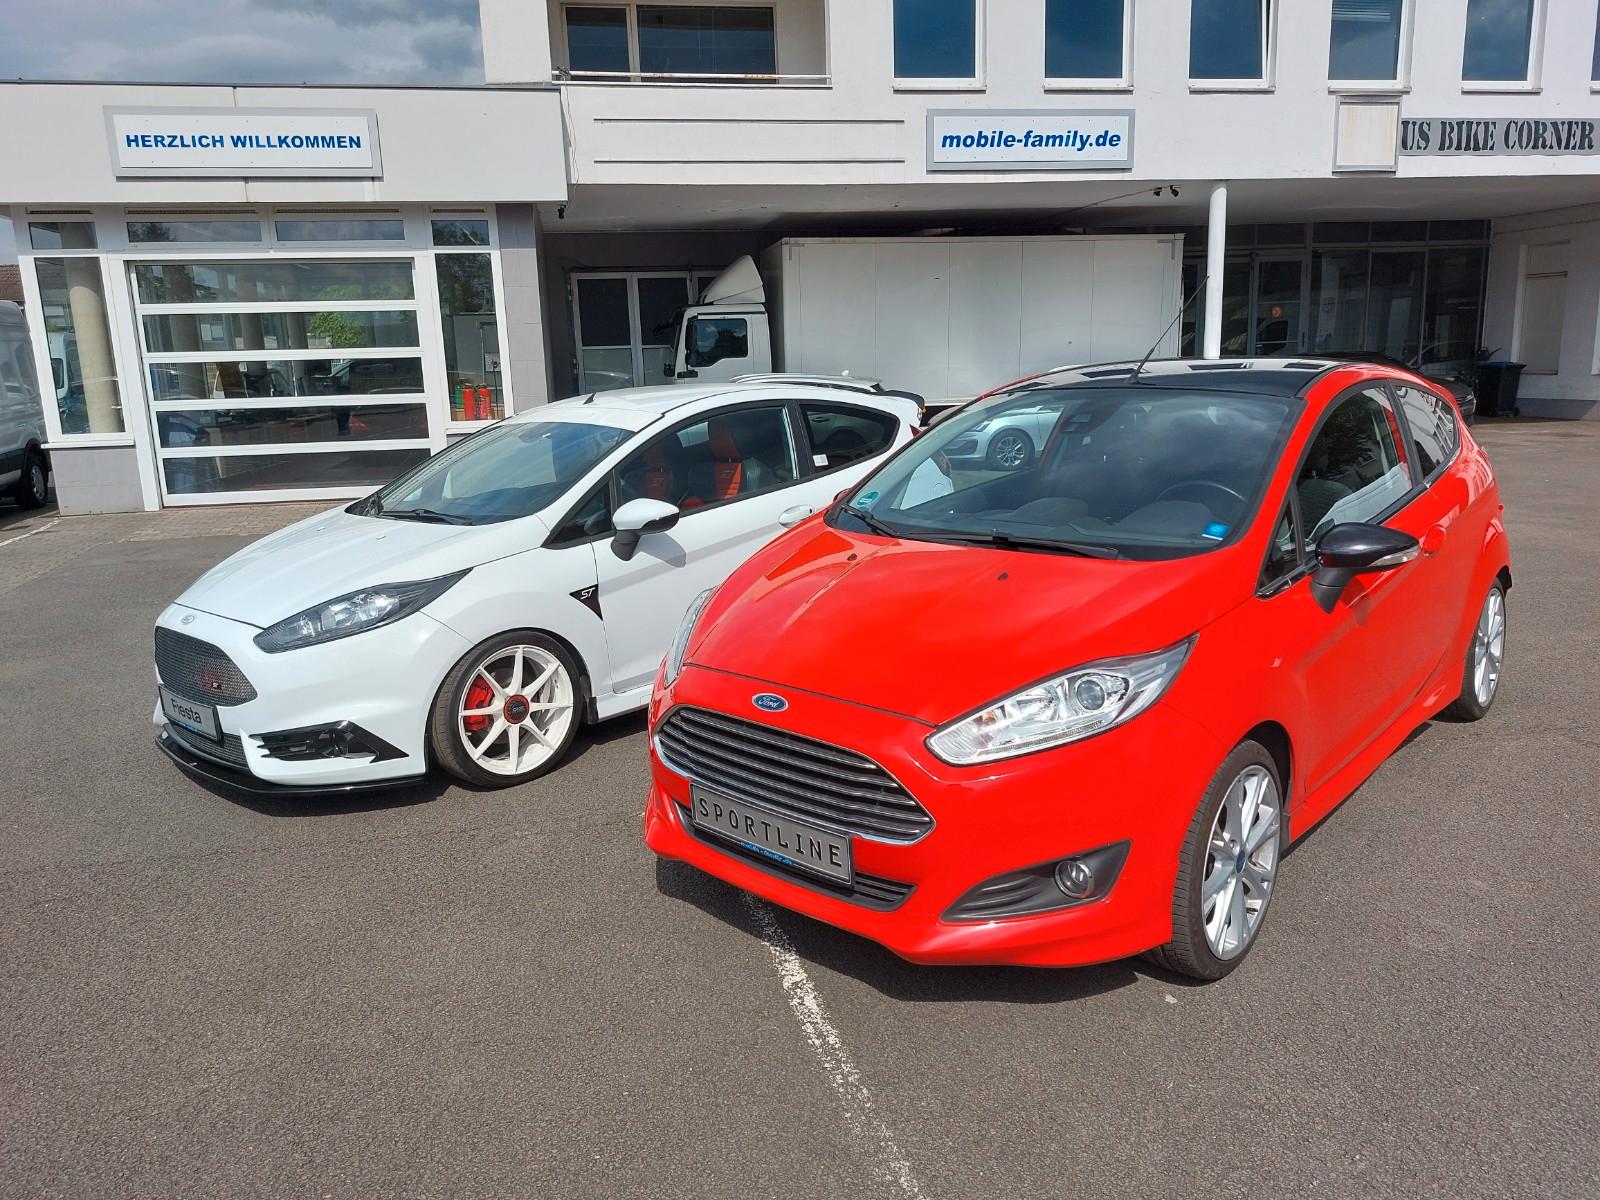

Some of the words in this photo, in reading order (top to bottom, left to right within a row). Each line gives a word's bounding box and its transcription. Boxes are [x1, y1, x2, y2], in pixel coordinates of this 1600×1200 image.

[126, 134, 224, 148] HERZLICH
[230, 135, 361, 149] WILLKOMMEN
[941, 130, 1121, 151] mobile-family.de
[1401, 120, 1431, 151] US
[1438, 120, 1497, 151] BIKE
[1503, 120, 1595, 151] CORNER
[580, 587, 596, 600] ST
[171, 697, 203, 724] Fiesta
[700, 797, 842, 868] SPORTLINE
